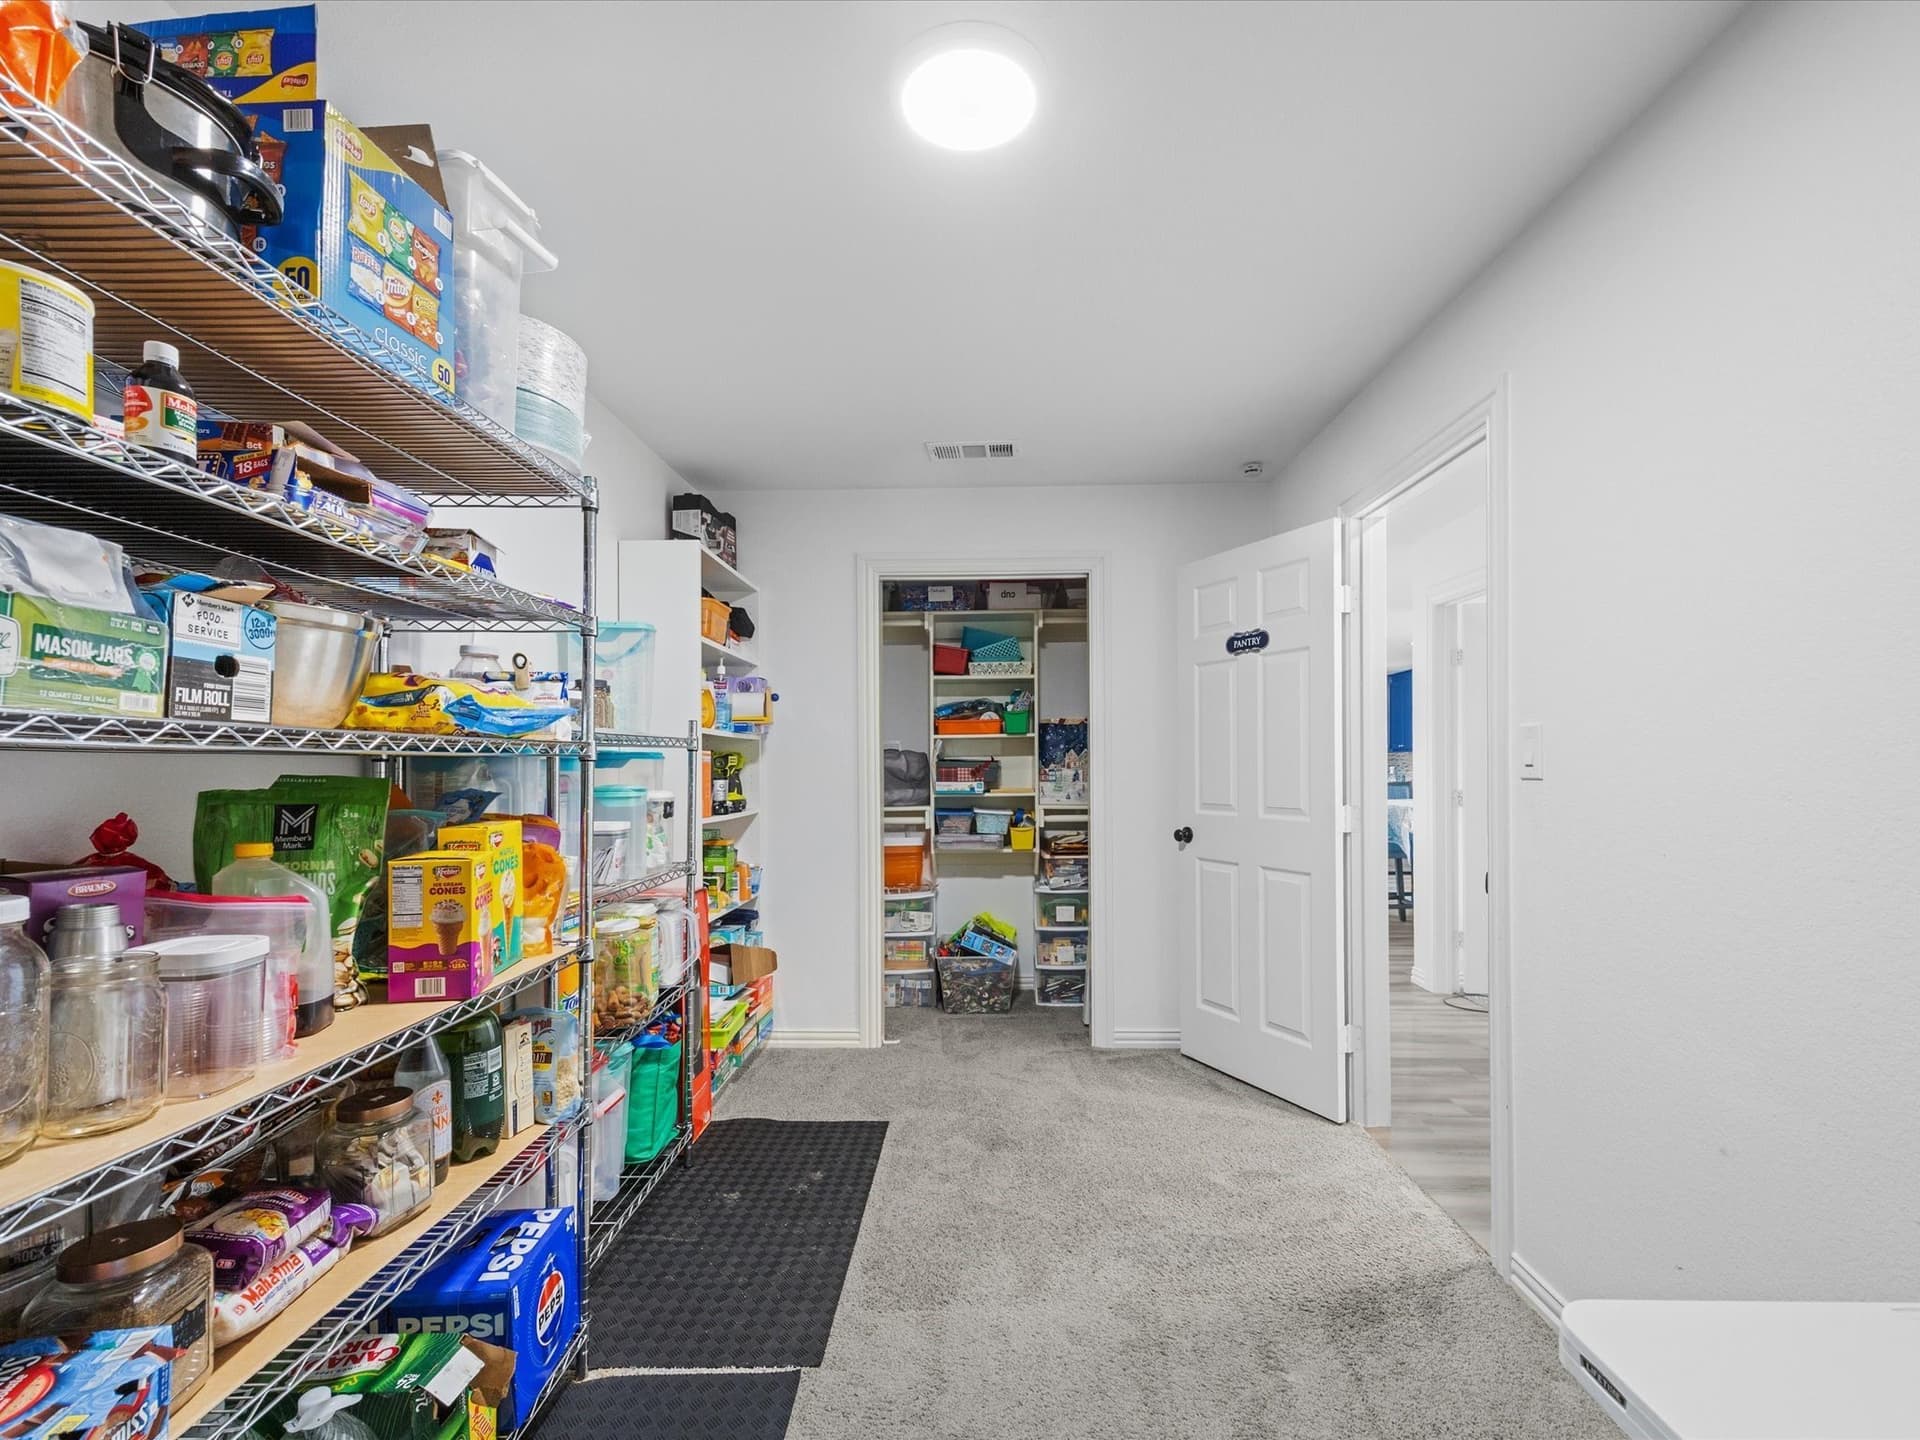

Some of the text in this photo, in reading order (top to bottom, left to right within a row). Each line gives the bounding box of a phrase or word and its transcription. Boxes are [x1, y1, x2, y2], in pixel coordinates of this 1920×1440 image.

[255, 236, 264, 249] 16
[284, 266, 311, 291] 50
[374, 327, 428, 368] classic
[437, 364, 451, 386] 50
[235, 462, 253, 475] 18
[196, 610, 221, 624] FOOD
[187, 623, 229, 640] SERVICE
[35, 632, 136, 667] MASON JARS
[1233, 636, 1262, 649] PANTRY
[175, 686, 230, 706] FILM ROLL
[274, 835, 312, 843] Member's
[493, 854, 519, 875] CONES
[429, 887, 466, 896] CONES
[478, 1208, 563, 1282] PEPSI
[240, 1253, 302, 1306] Mahatma
[537, 1284, 565, 1331] PEPSI
[398, 1311, 505, 1338] PEPSI
